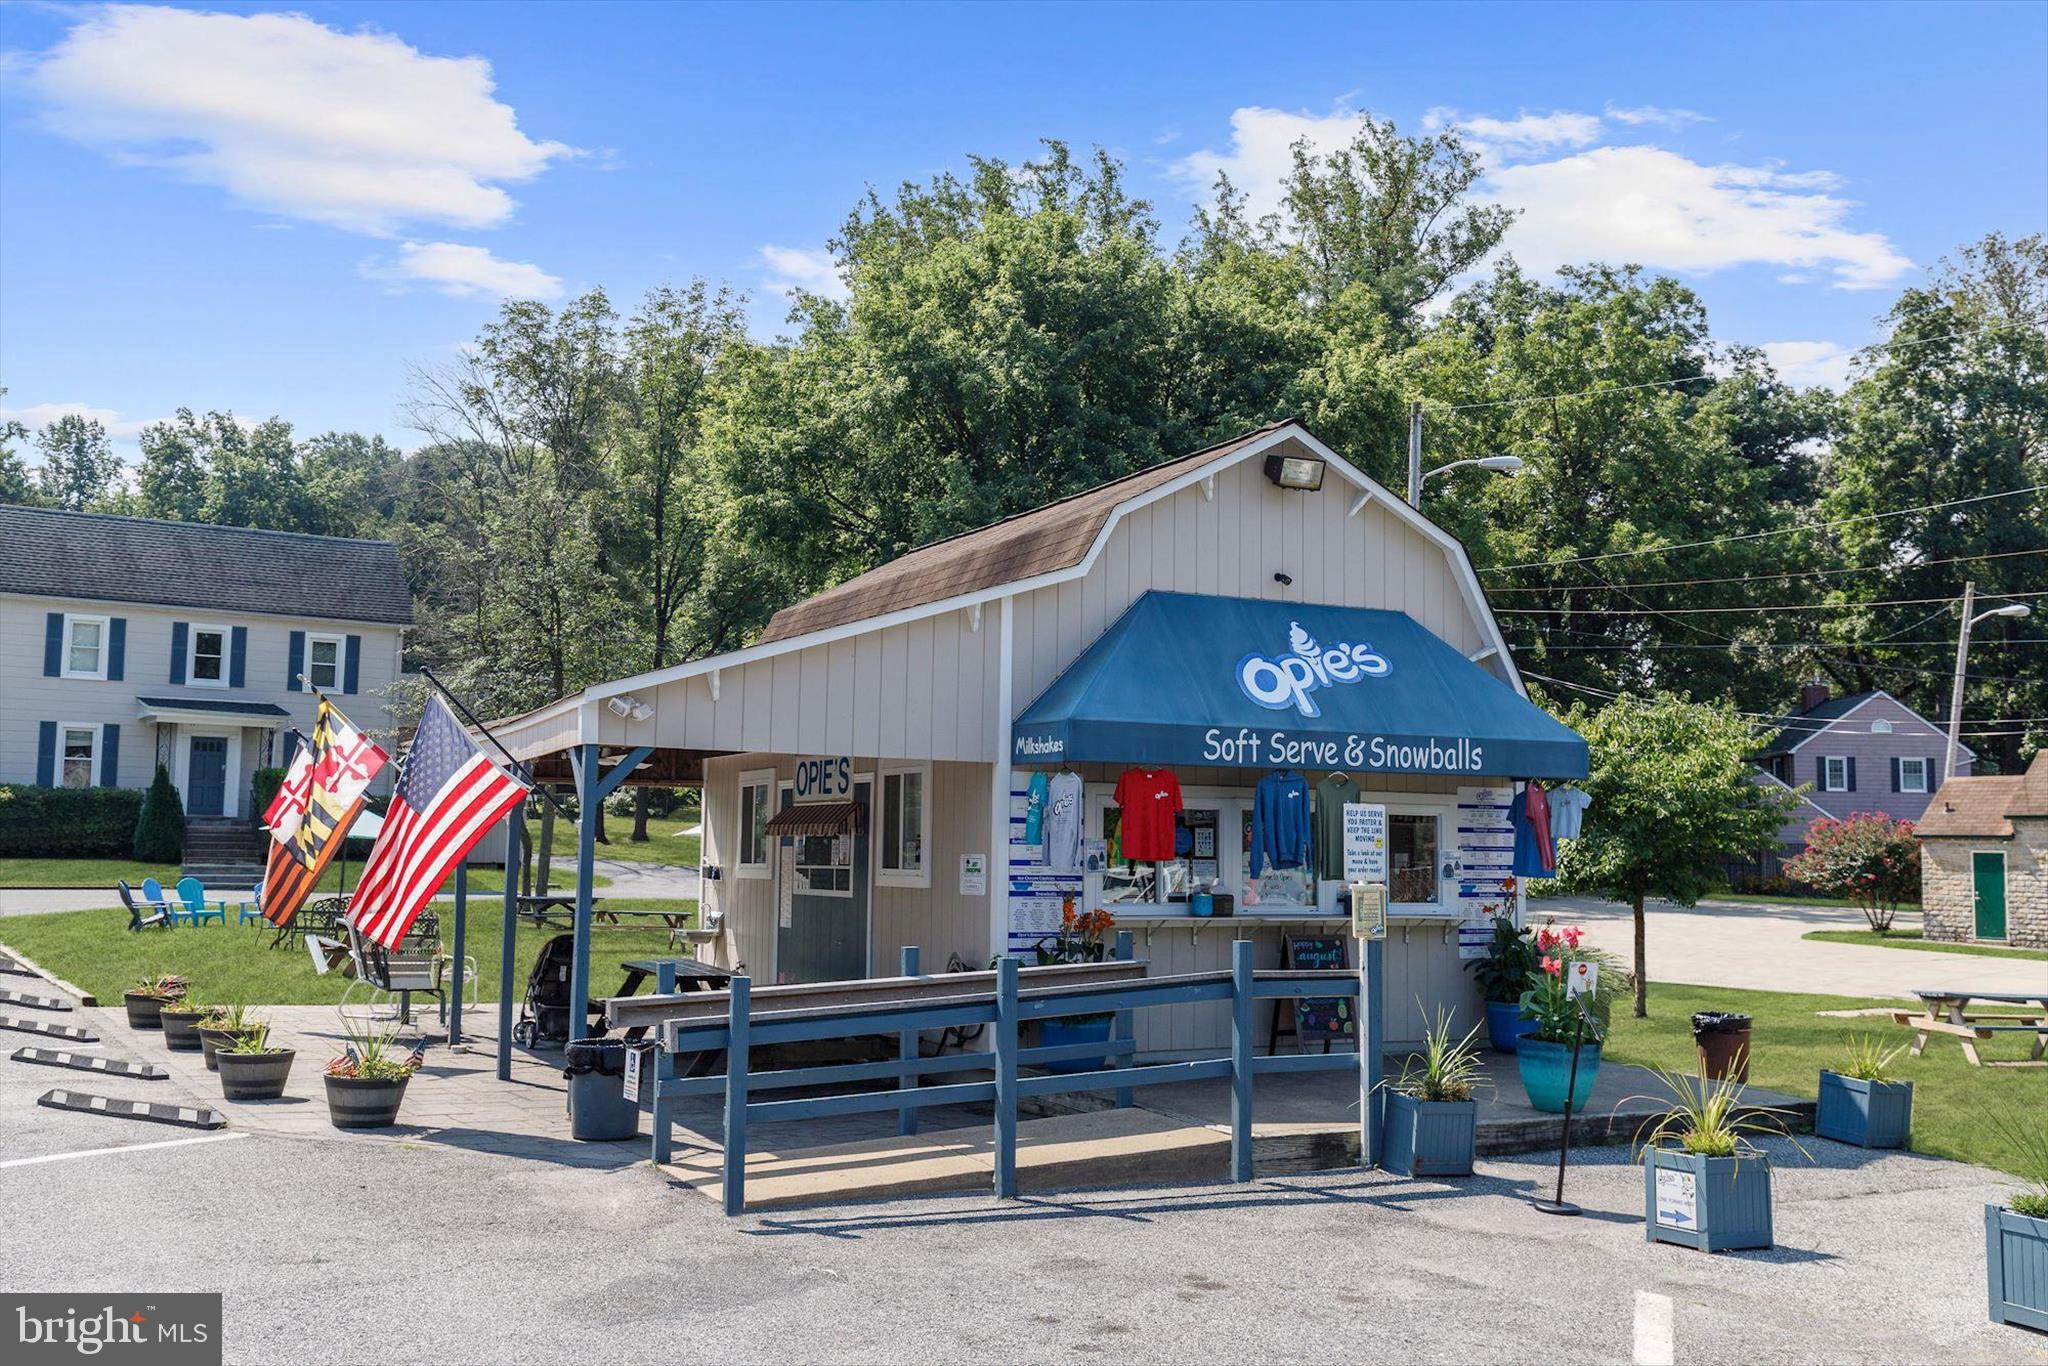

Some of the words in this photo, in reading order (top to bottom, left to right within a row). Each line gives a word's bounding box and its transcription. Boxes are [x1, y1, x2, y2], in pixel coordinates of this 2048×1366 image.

[1239, 630, 1391, 717] Opie's
[1015, 735, 1064, 756] Milkshakes
[1203, 728, 1261, 764] Soft
[1268, 732, 1339, 766] Serve
[1344, 734, 1366, 767] &
[1369, 736, 1483, 771] Snowballs
[796, 757, 850, 797] OPIE'S
[1346, 809, 1359, 818] HELP
[1360, 810, 1367, 818] US
[1368, 810, 1384, 819] SERVE
[1347, 826, 1359, 834] KEEP
[1361, 826, 1370, 835] THE
[1355, 835, 1375, 843] MOVING
